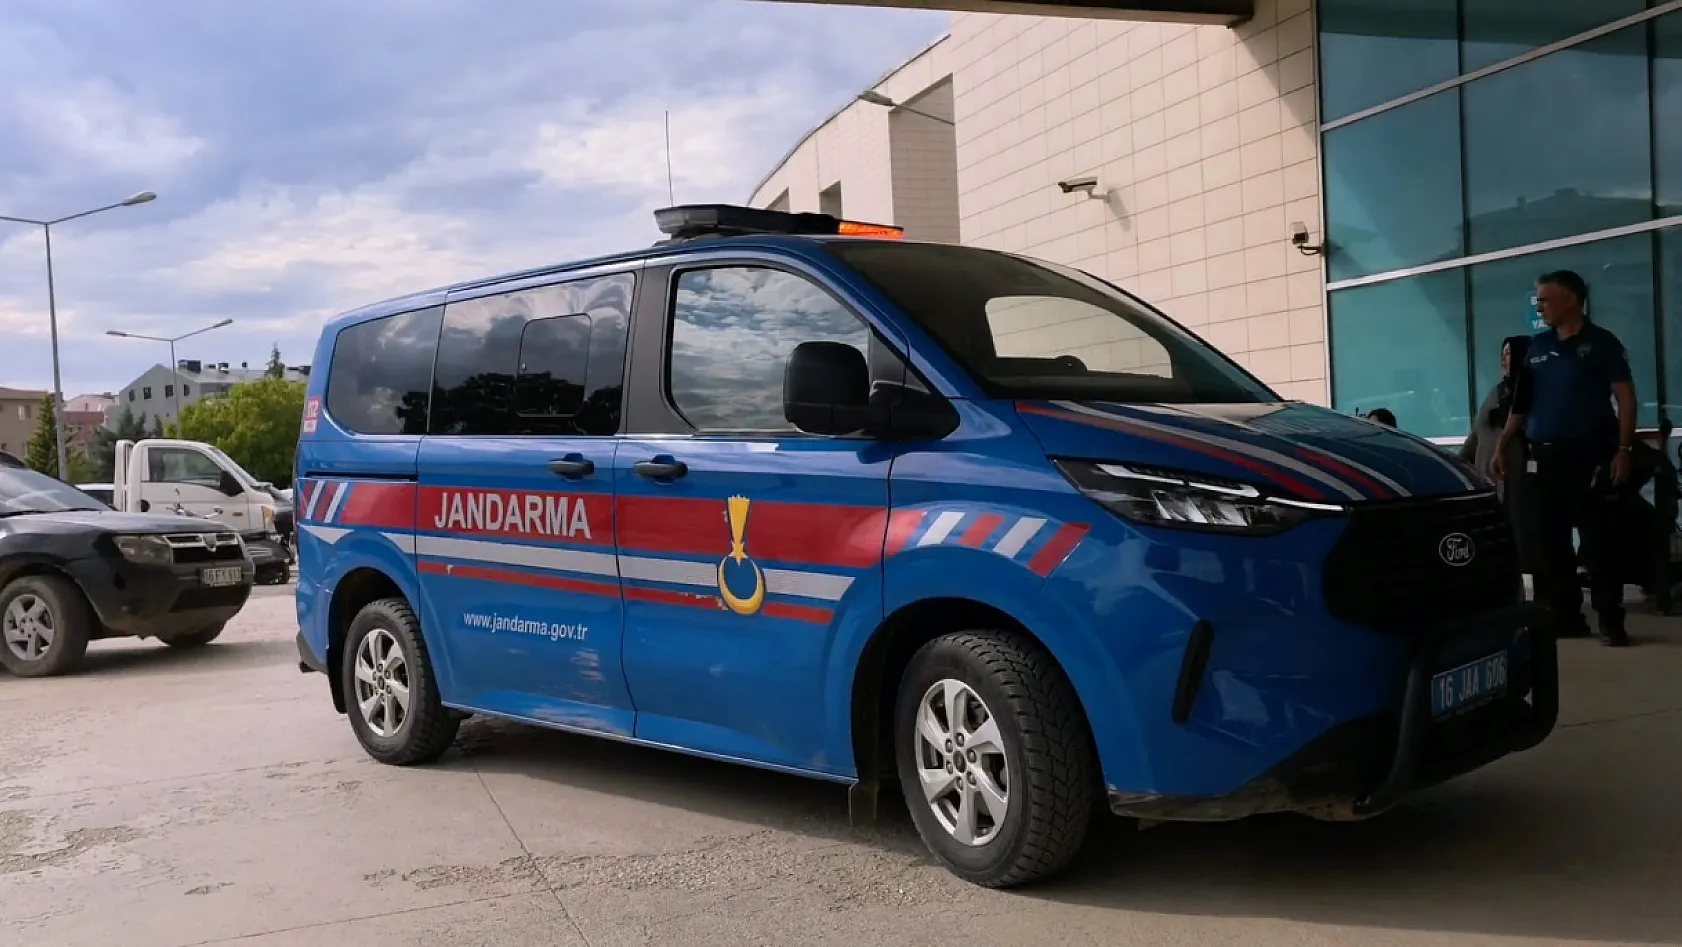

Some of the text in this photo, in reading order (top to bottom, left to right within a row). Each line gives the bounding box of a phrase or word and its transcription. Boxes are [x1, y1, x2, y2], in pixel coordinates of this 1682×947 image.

[434, 492, 592, 539] JANDARMA
[1447, 537, 1469, 560] Ford
[463, 612, 588, 641] www.jandarma.gov.tr
[1440, 674, 1454, 709] 16
[1459, 665, 1480, 701] JAA
